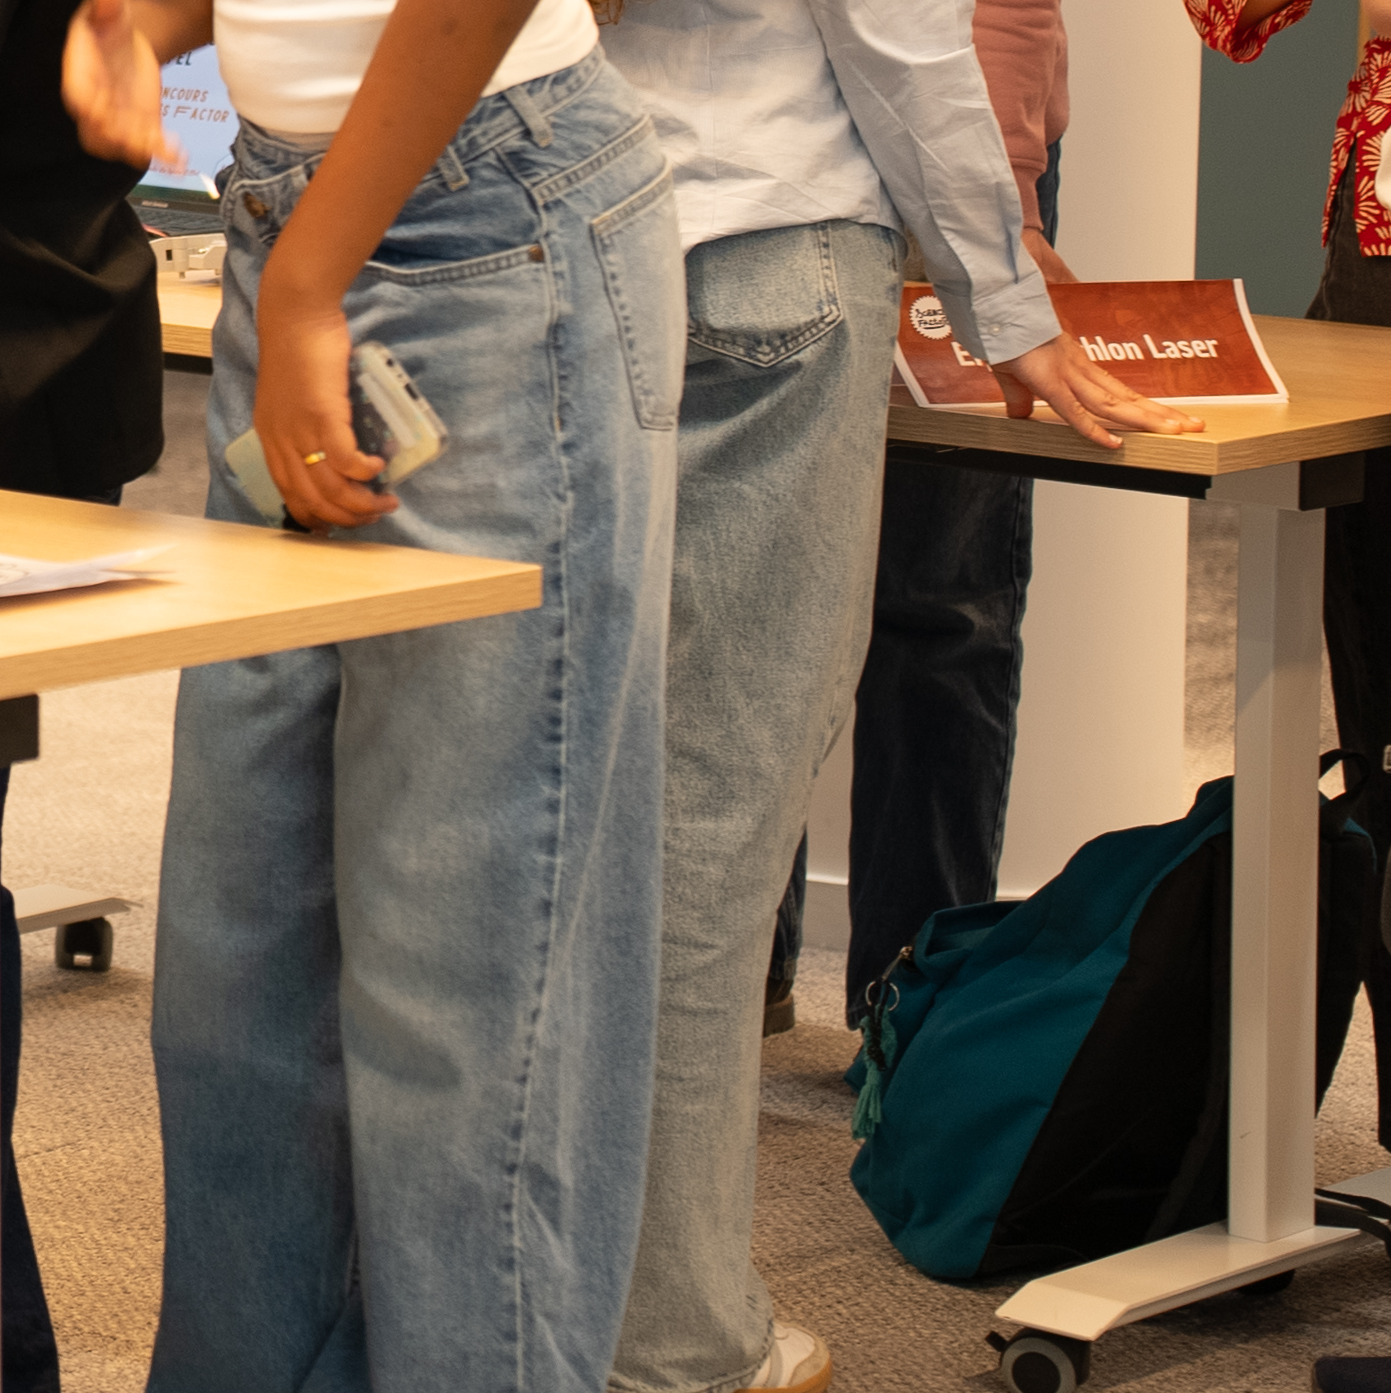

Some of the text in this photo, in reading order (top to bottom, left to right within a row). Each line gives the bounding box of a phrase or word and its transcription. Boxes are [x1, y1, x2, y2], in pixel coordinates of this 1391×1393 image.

[161, 87, 209, 103] NCOURS
[173, 106, 230, 123] FACTOR
[1079, 334, 1218, 362] hlon Laser
